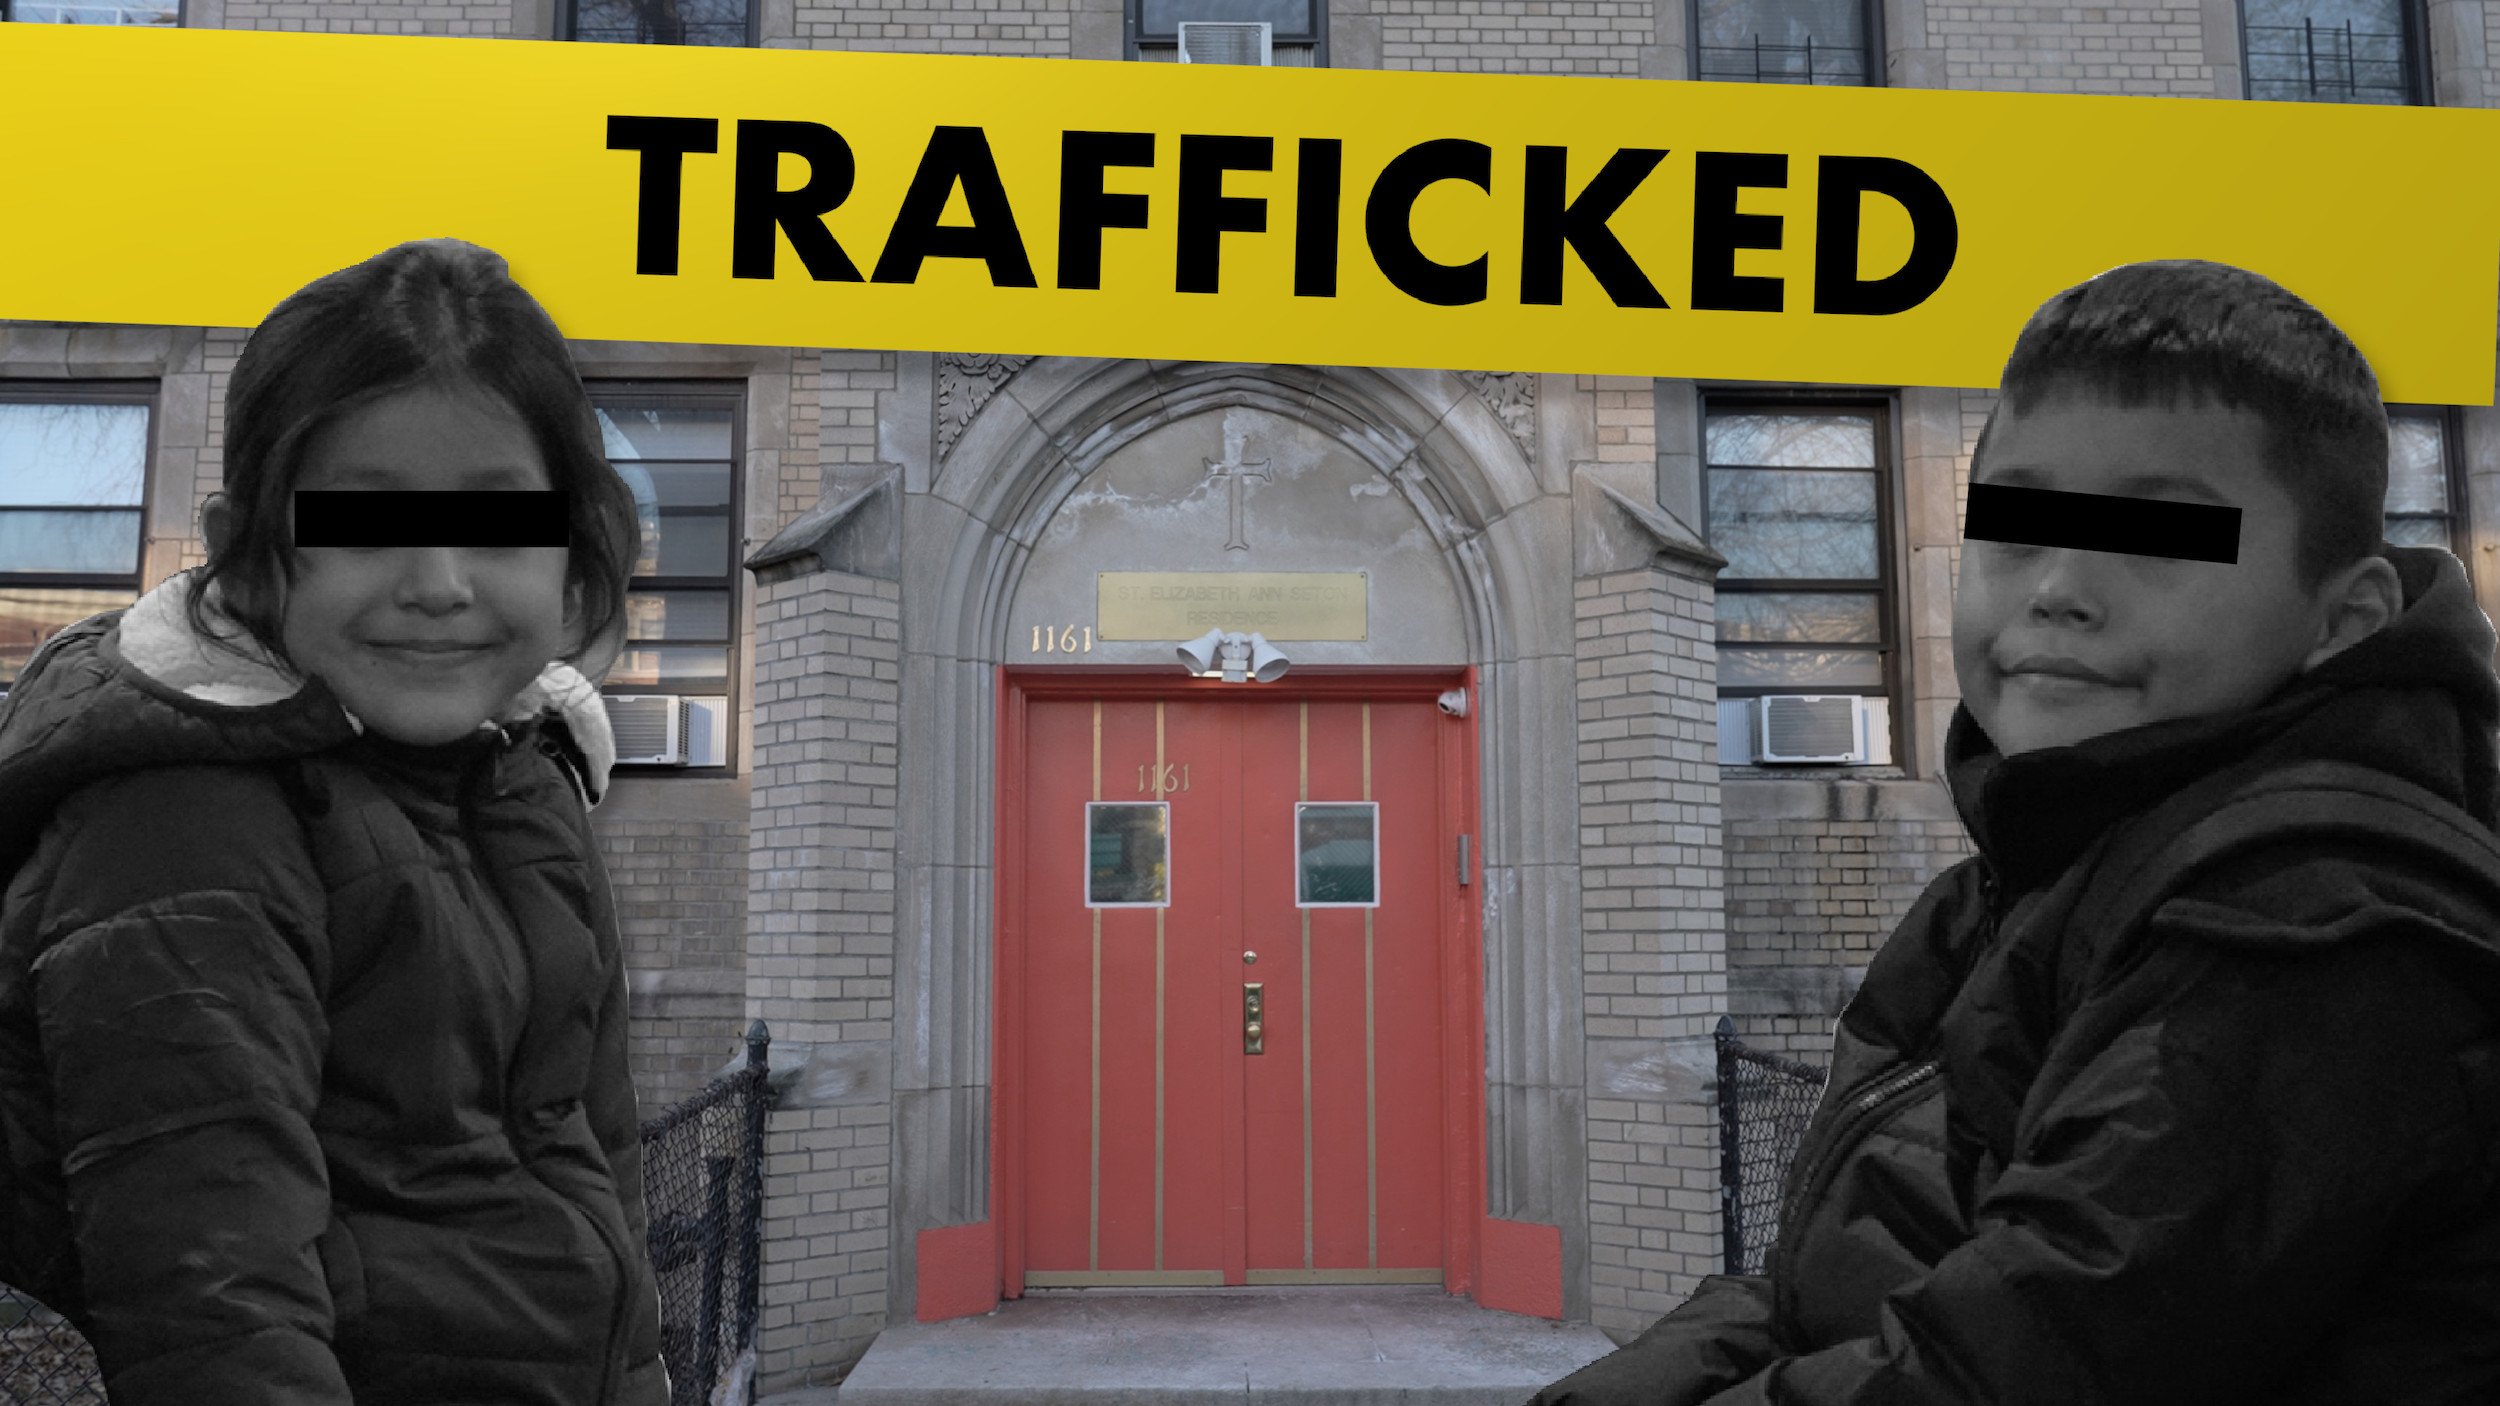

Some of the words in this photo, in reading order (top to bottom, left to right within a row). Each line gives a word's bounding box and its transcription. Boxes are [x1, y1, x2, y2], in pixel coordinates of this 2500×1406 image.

[1117, 586, 1145, 601] ST.
[1150, 586, 1240, 601] ELIZABETH
[1247, 586, 1282, 601] ANN
[1289, 586, 1348, 601] SETON
[1186, 611, 1279, 625] RESIDENCE
[1031, 623, 1092, 653] 1161
[1137, 762, 1190, 793] 1161
